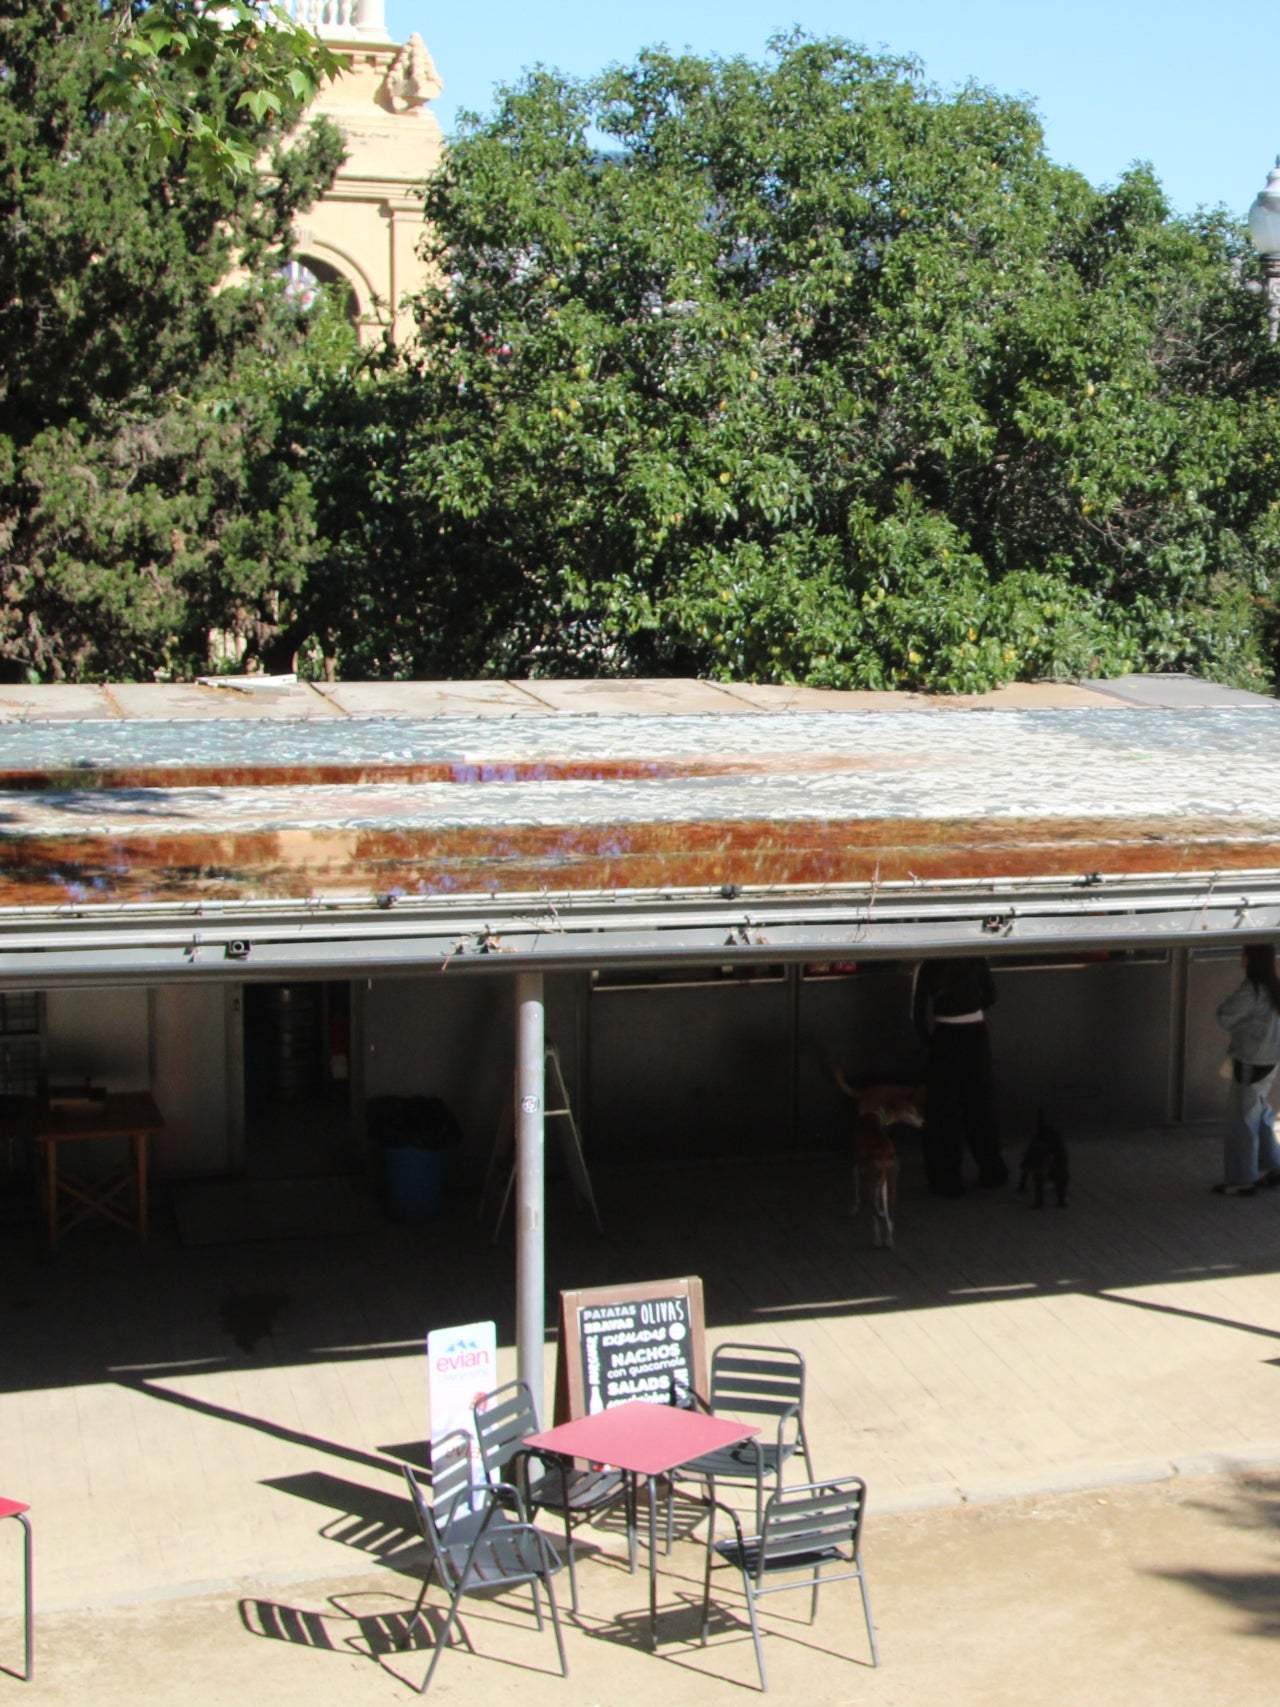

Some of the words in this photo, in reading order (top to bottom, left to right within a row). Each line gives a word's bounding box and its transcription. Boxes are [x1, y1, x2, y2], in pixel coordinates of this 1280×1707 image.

[584, 1305, 637, 1321] PATATAS
[640, 1300, 684, 1325] OLIVAS
[583, 1318, 634, 1334] BRAVAS
[436, 1350, 489, 1373] evian
[611, 1343, 681, 1368] NACHOS
[607, 1366, 627, 1379] con
[607, 1375, 670, 1396] SALADS
